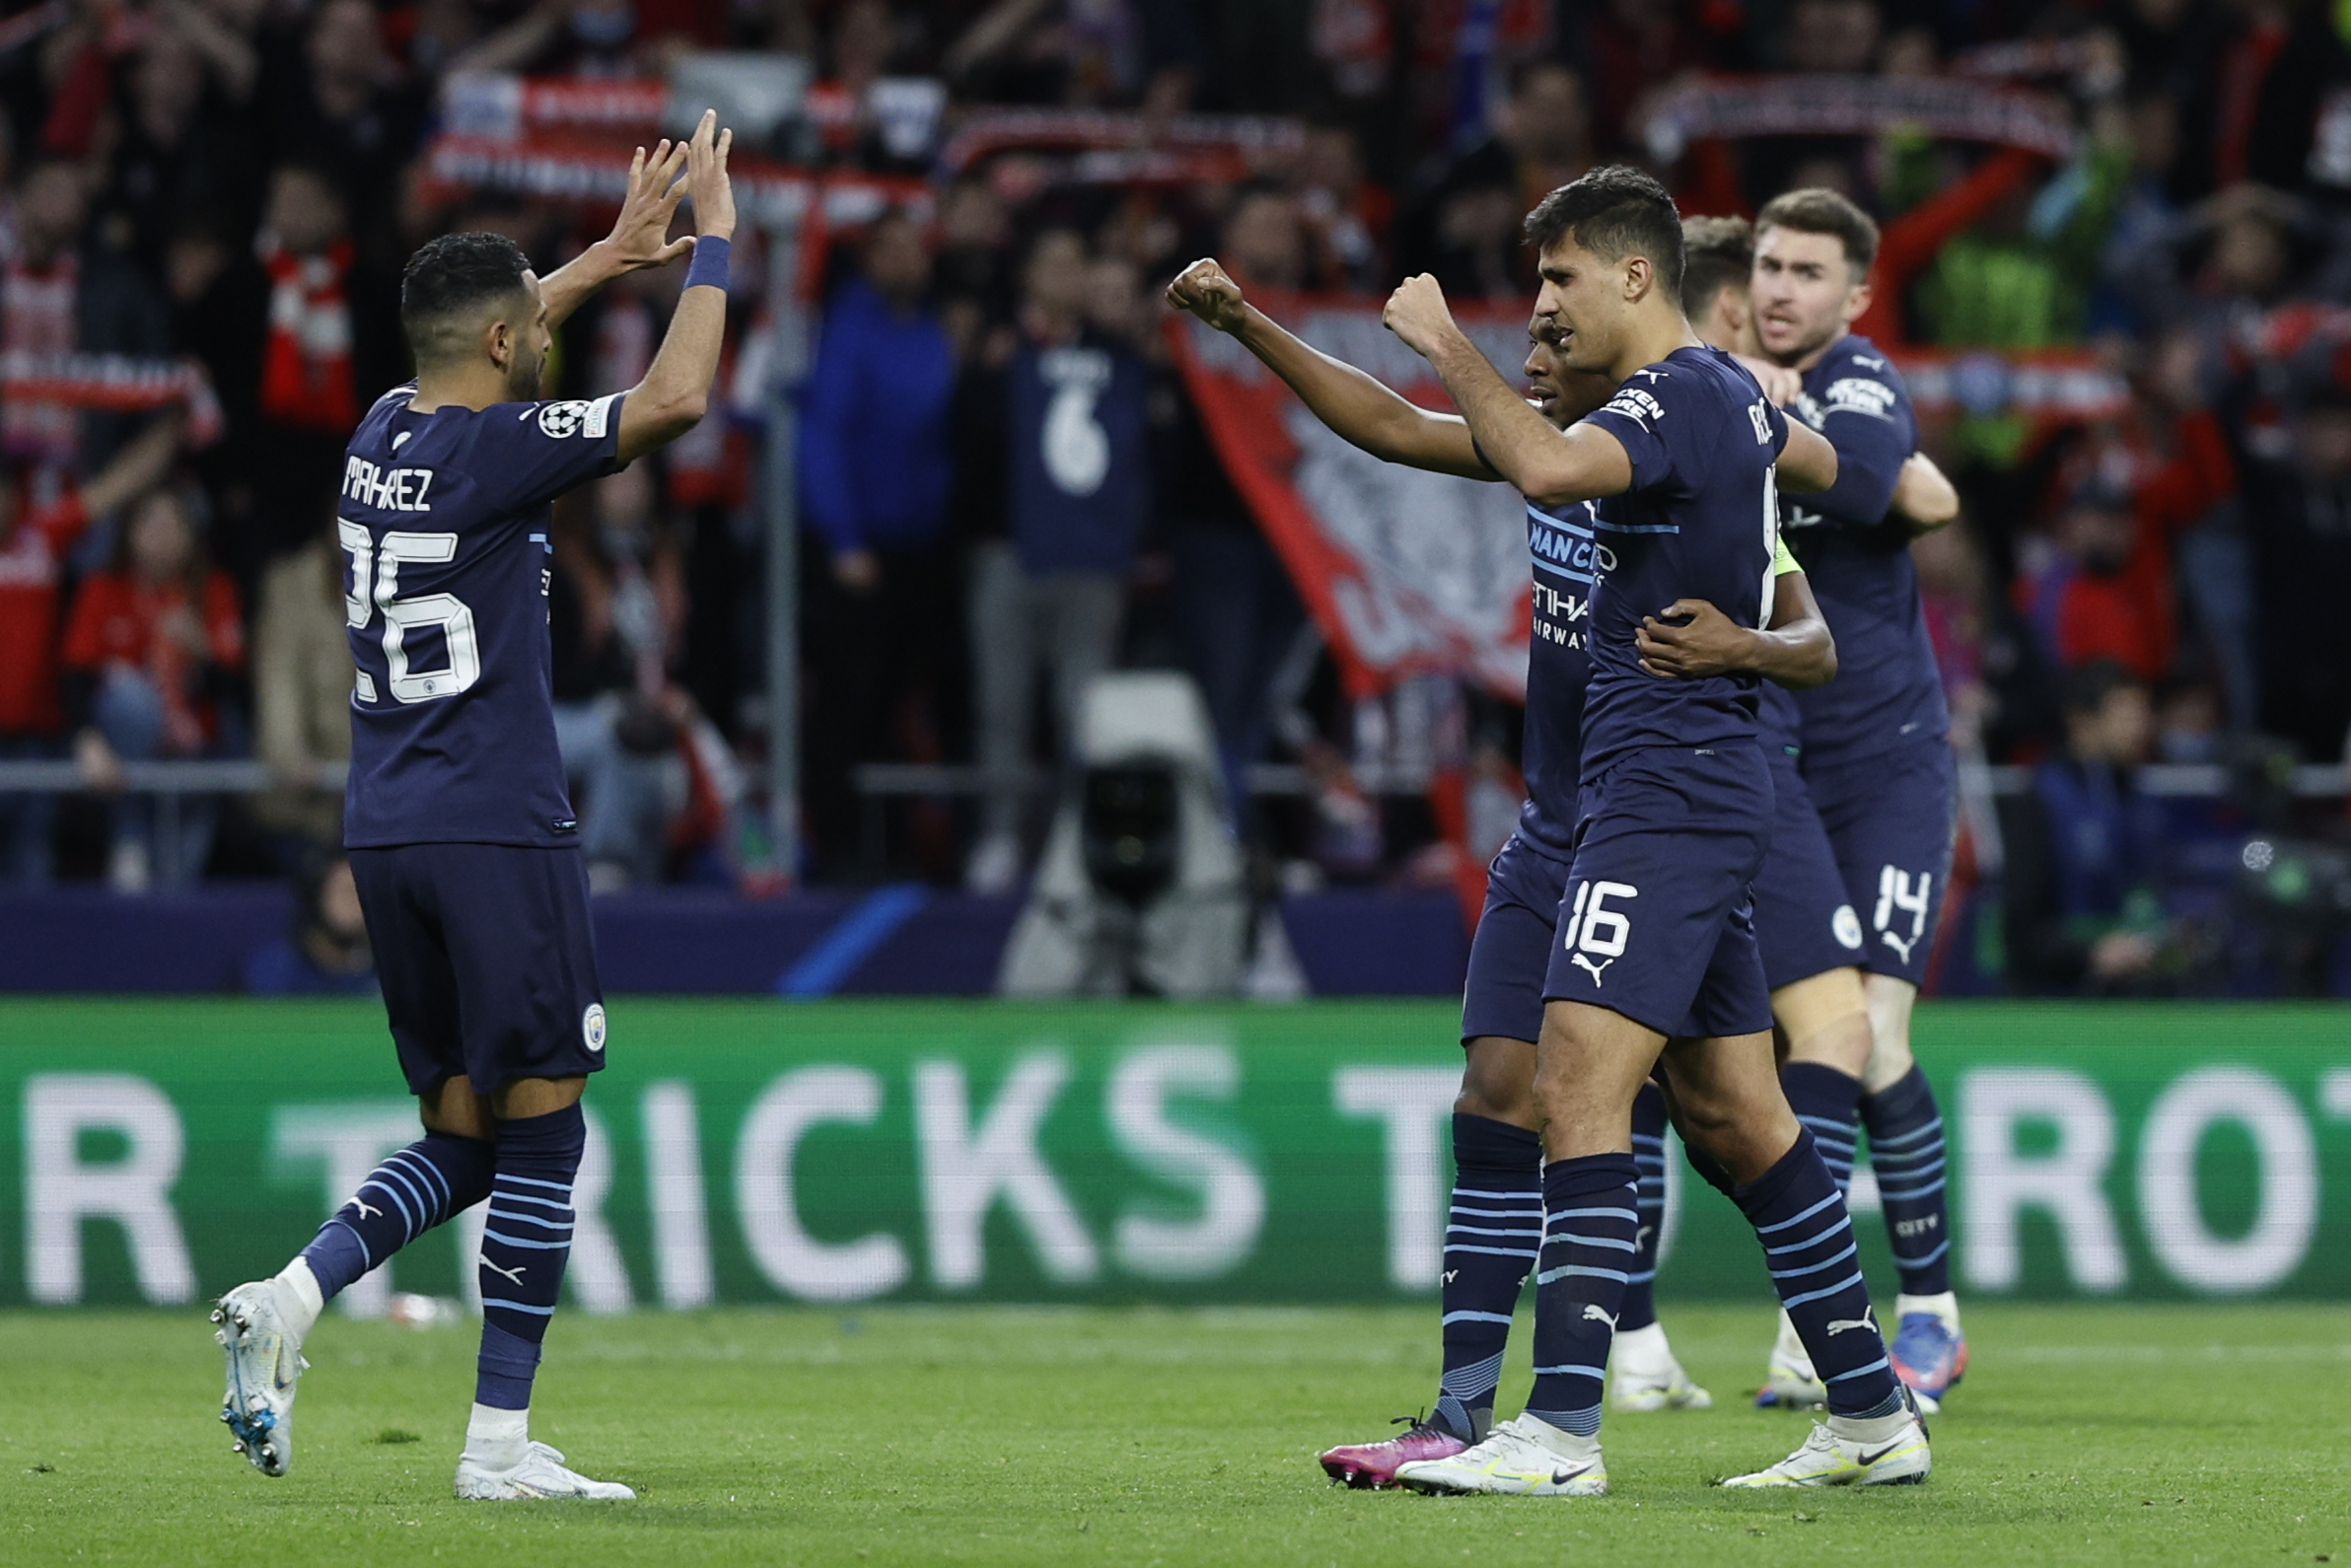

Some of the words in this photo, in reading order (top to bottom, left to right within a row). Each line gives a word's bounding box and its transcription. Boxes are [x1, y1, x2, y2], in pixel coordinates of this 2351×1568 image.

[341, 456, 434, 512] MAHREZ
[1530, 523, 1573, 563] MAN
[337, 516, 481, 704] 26
[1565, 880, 1638, 957] 16
[1873, 864, 1932, 937] 14
[1895, 1212, 1939, 1238] CITY
